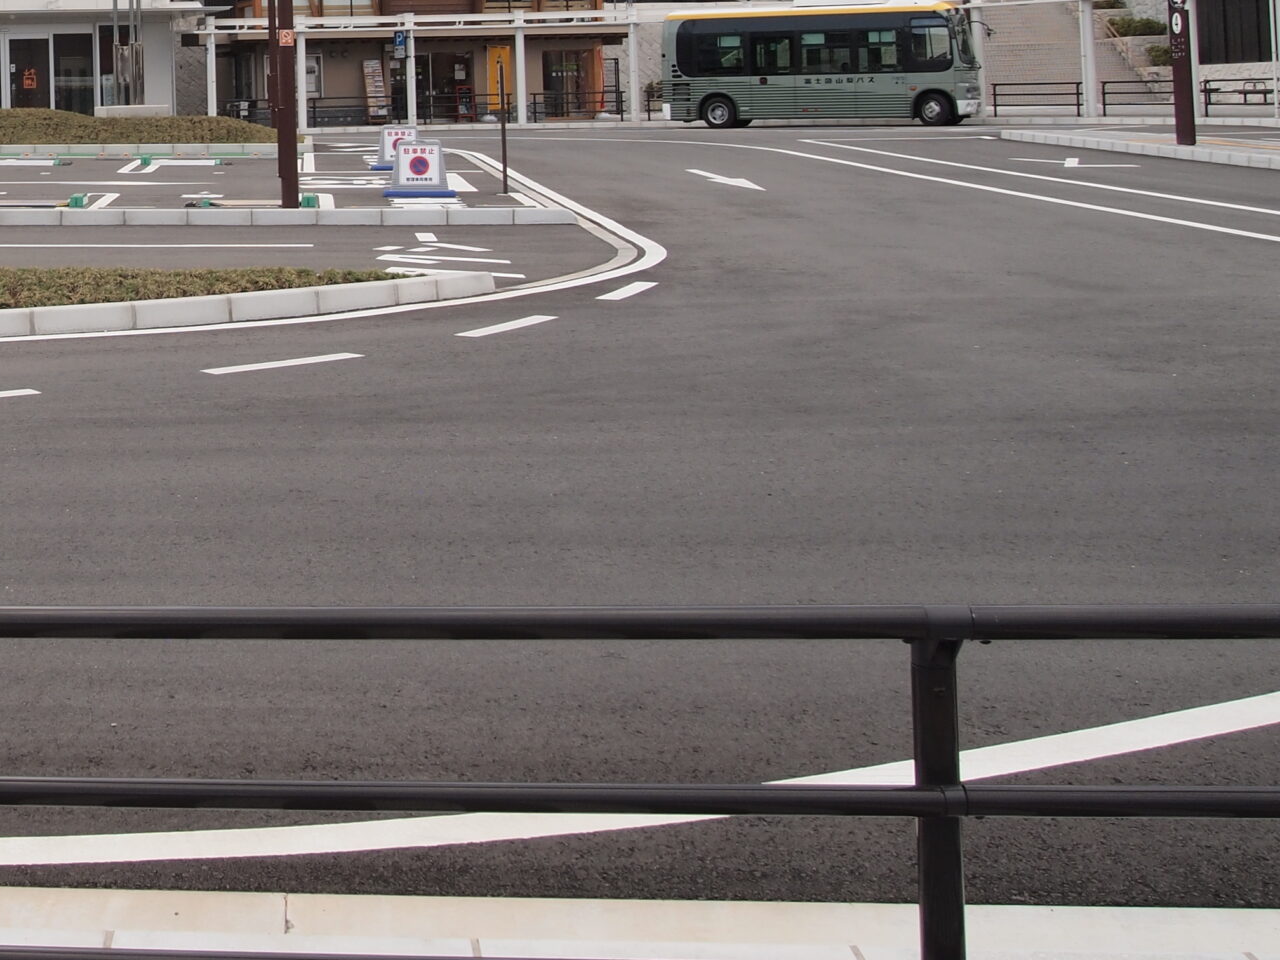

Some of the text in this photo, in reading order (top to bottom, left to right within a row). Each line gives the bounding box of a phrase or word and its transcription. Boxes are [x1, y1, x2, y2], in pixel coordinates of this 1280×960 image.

[395, 32, 403, 45] P
[804, 76, 875, 85] 富士急山梨バス
[403, 147, 435, 155] 駐車禁止
